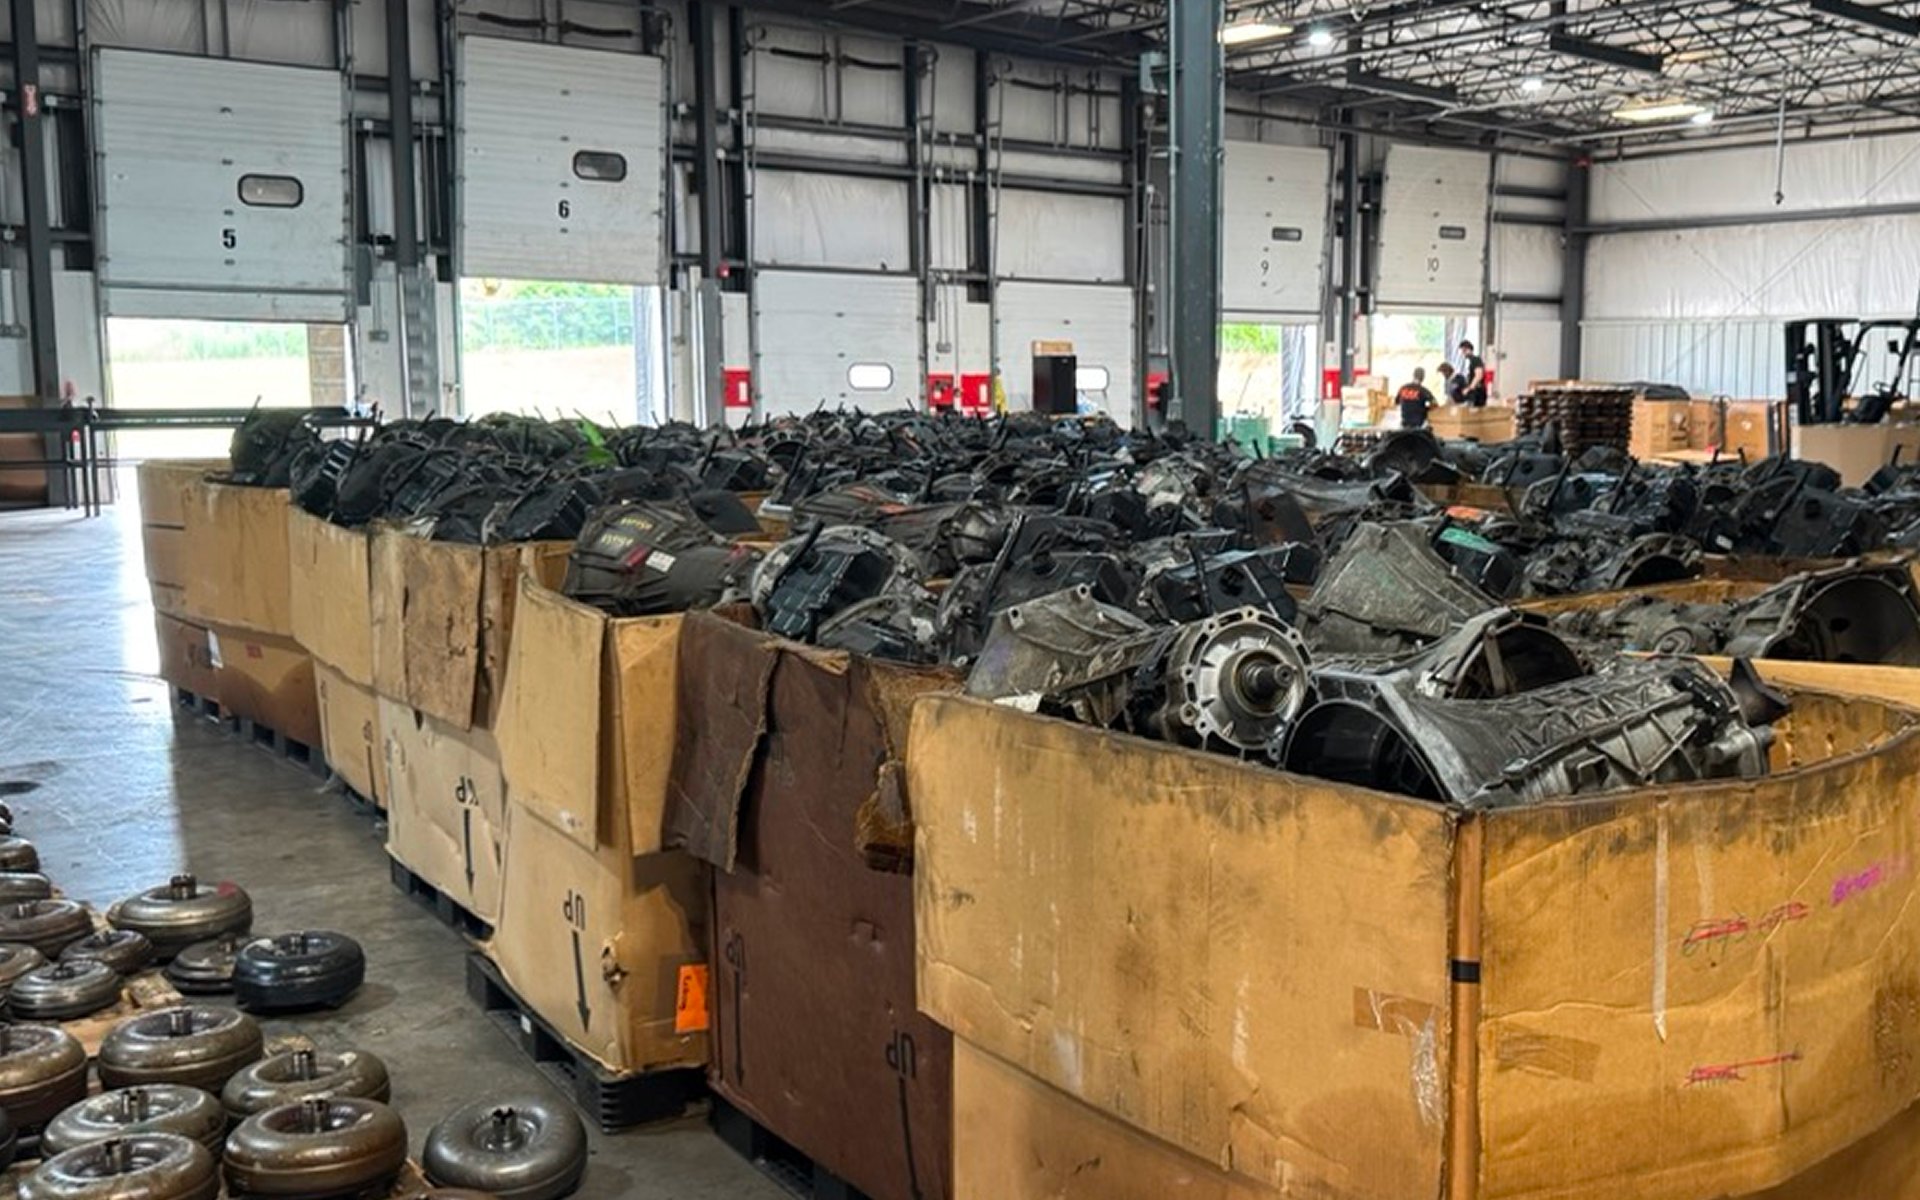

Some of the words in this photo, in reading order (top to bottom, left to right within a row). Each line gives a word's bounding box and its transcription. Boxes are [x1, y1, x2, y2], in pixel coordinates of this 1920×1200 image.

[558, 199, 570, 219] 6
[222, 228, 237, 250] 5
[1260, 259, 1270, 275] 9
[1426, 257, 1440, 272] 10
[563, 888, 586, 931] UP
[726, 931, 747, 971] UP
[885, 1029, 917, 1079] UP
